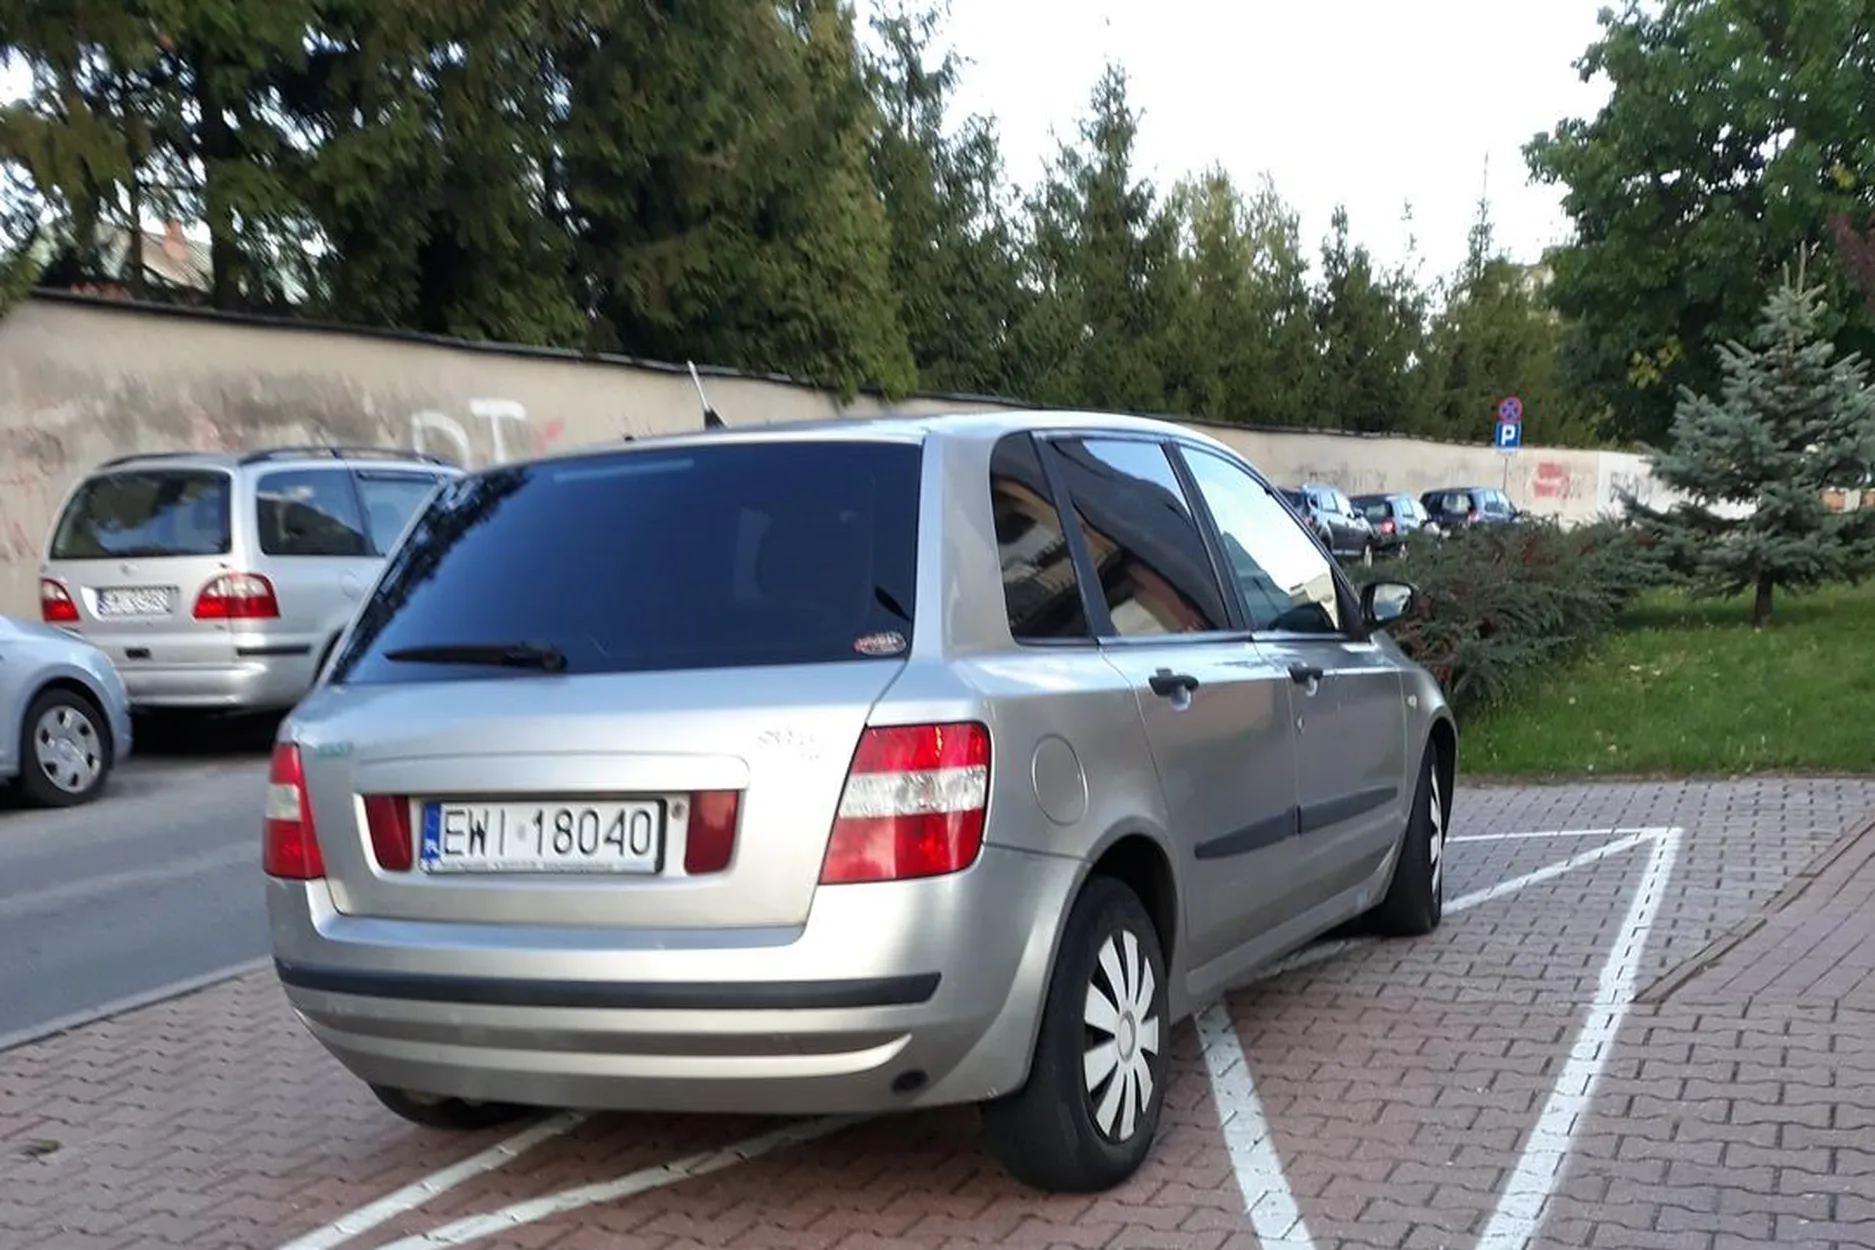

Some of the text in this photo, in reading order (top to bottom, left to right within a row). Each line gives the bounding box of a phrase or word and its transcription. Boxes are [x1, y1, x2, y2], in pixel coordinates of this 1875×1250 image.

[1501, 424, 1516, 445] P
[445, 808, 651, 856] EWI 18040
